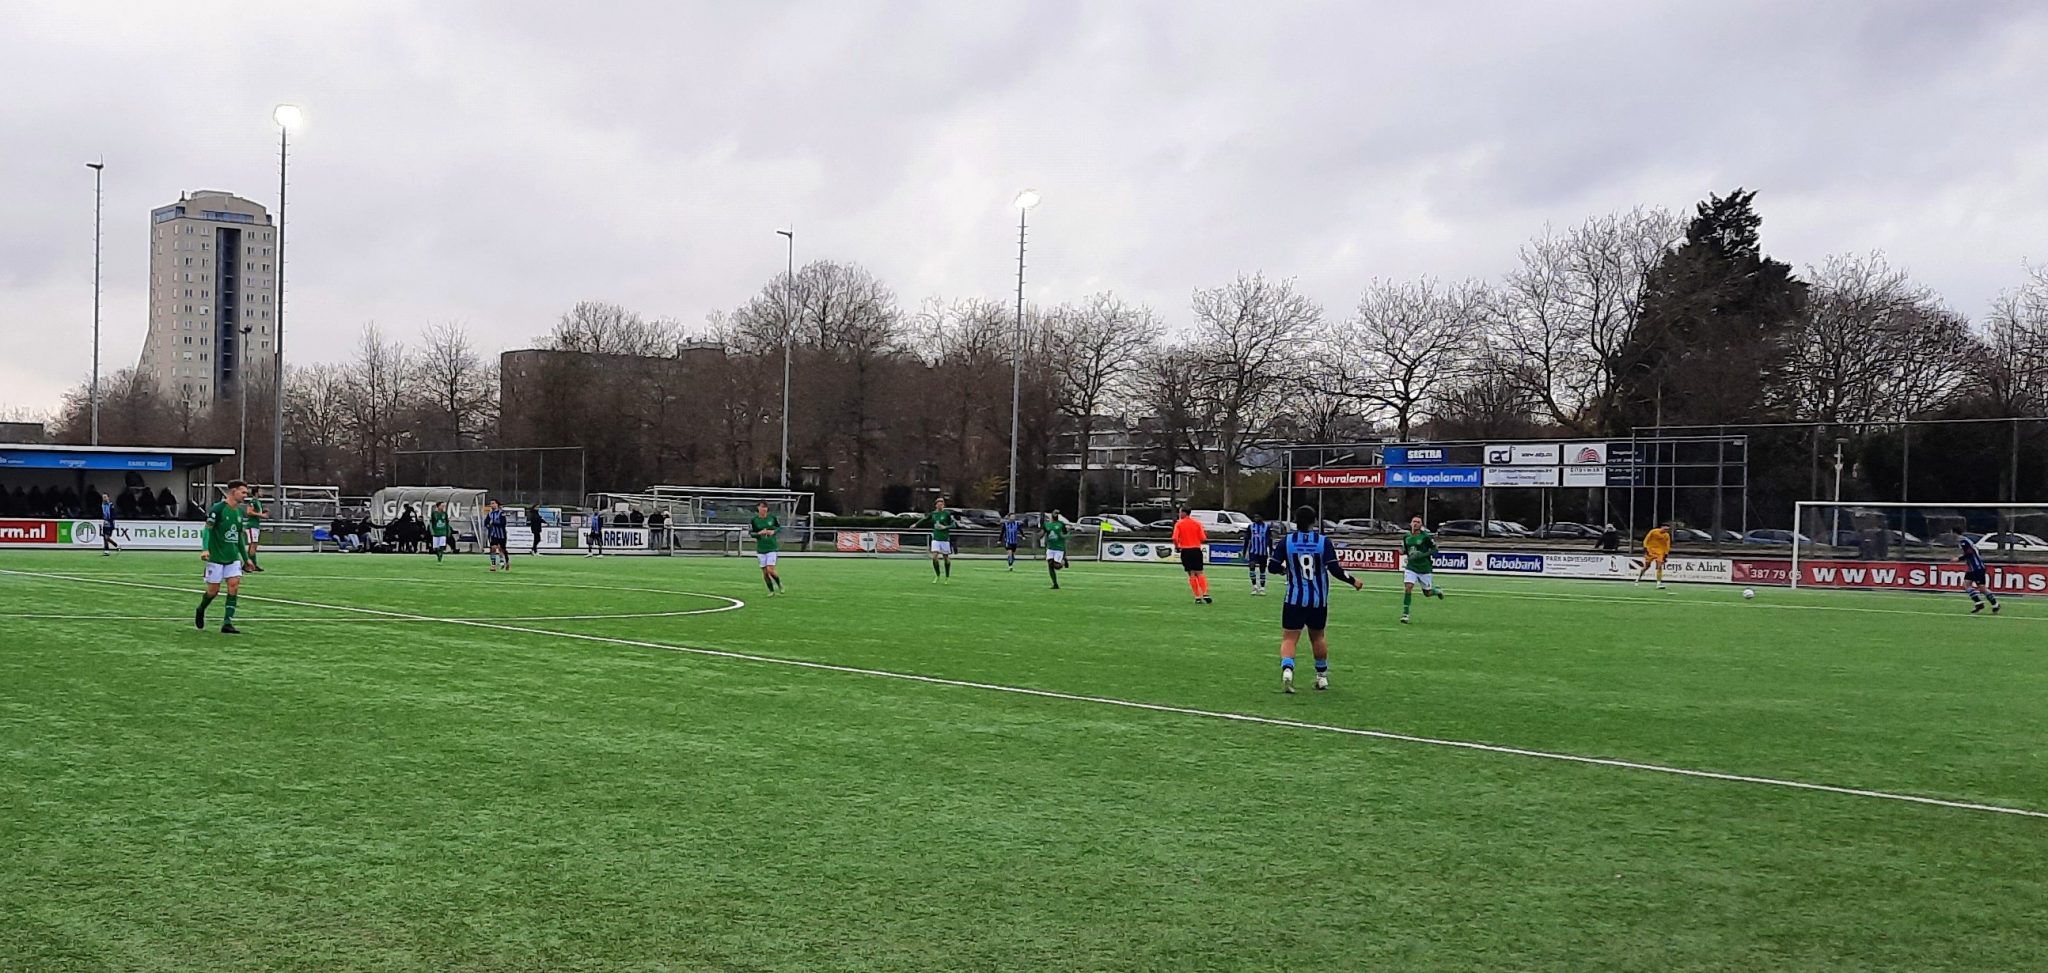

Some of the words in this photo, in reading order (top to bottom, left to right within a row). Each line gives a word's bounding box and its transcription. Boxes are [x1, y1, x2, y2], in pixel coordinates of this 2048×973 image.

[1407, 449, 1442, 458] SECTRA
[1317, 473, 1380, 484] huuralarm.nl
[1408, 472, 1477, 485] koopalarm.nl
[384, 501, 460, 518] GASTN
[1334, 549, 1395, 562] PROPER
[1300, 554, 1313, 580] 8
[1488, 556, 1541, 570] Rabobank
[1685, 561, 1696, 571] &
[1697, 561, 1727, 573] Alink
[1751, 568, 1769, 579] 387
[1773, 569, 1786, 579] 79
